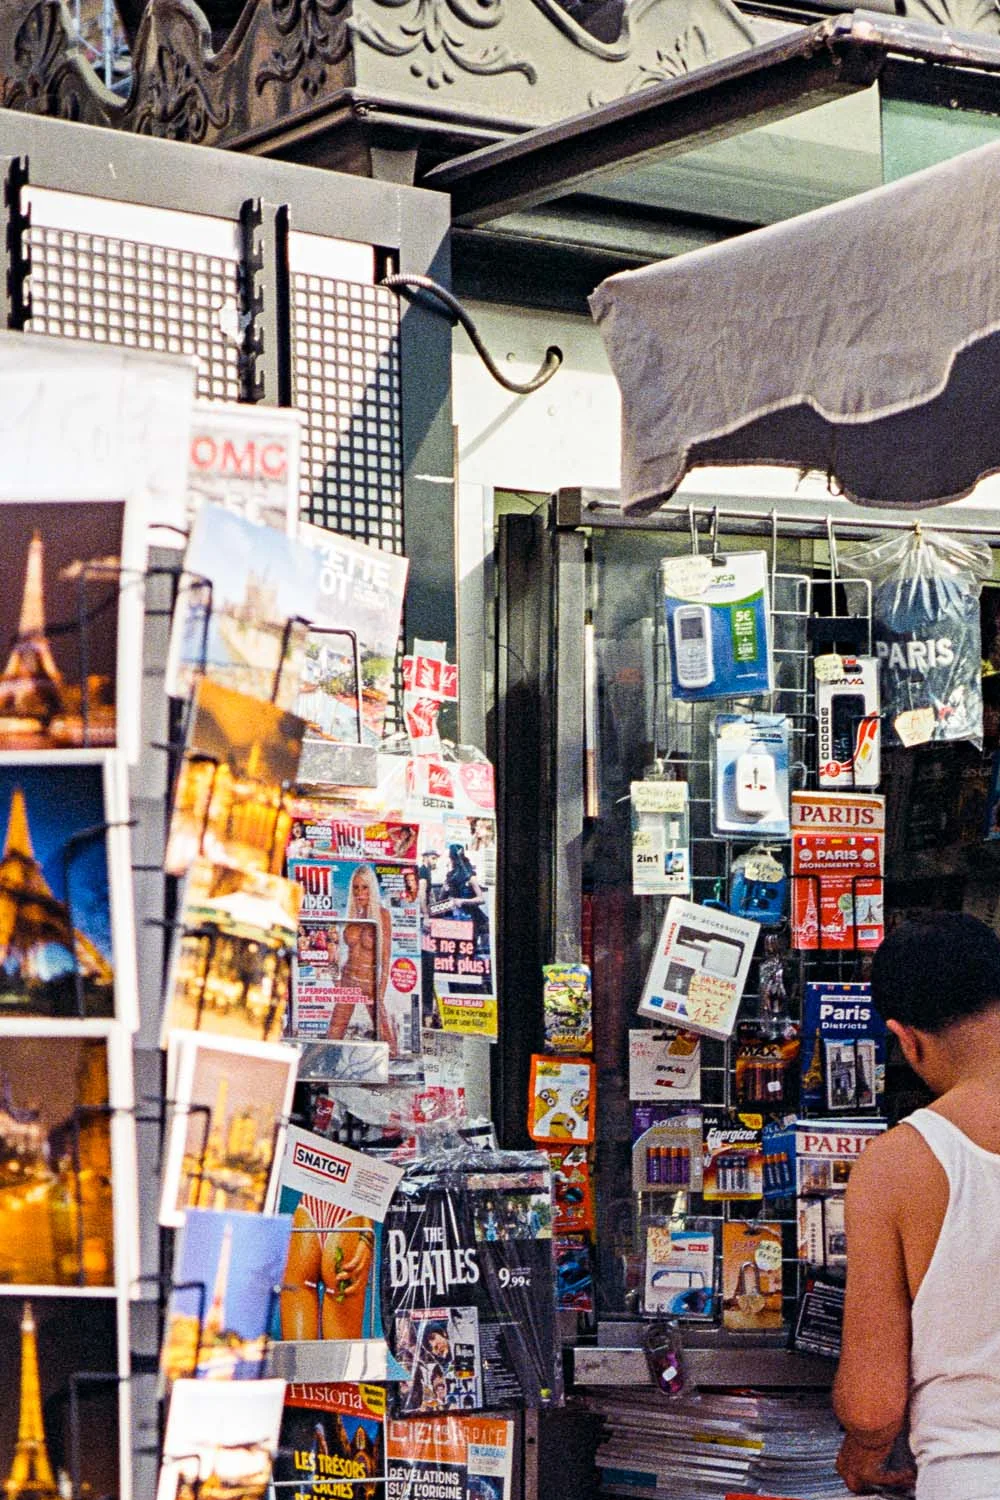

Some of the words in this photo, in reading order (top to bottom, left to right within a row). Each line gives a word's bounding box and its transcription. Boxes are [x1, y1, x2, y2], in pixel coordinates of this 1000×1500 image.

[874, 638, 955, 670] PARIS
[799, 805, 875, 825] PARIJS
[636, 853, 660, 864] 2in1
[815, 849, 859, 861] PARIS
[294, 866, 331, 897] HOT
[439, 940, 457, 952] ne
[459, 942, 474, 955] se
[819, 1004, 872, 1021] Paris
[821, 1021, 868, 1030] Districts
[706, 1127, 758, 1143] Energizer
[295, 1148, 347, 1178] SNATCH
[423, 1226, 447, 1243] THE
[387, 1229, 481, 1295] BEATLES
[290, 1382, 364, 1411] Historia
[293, 1450, 316, 1472] LES
[317, 1452, 366, 1479] TRÉSORS
[413, 1482, 463, 1500] L'ORIGINE
